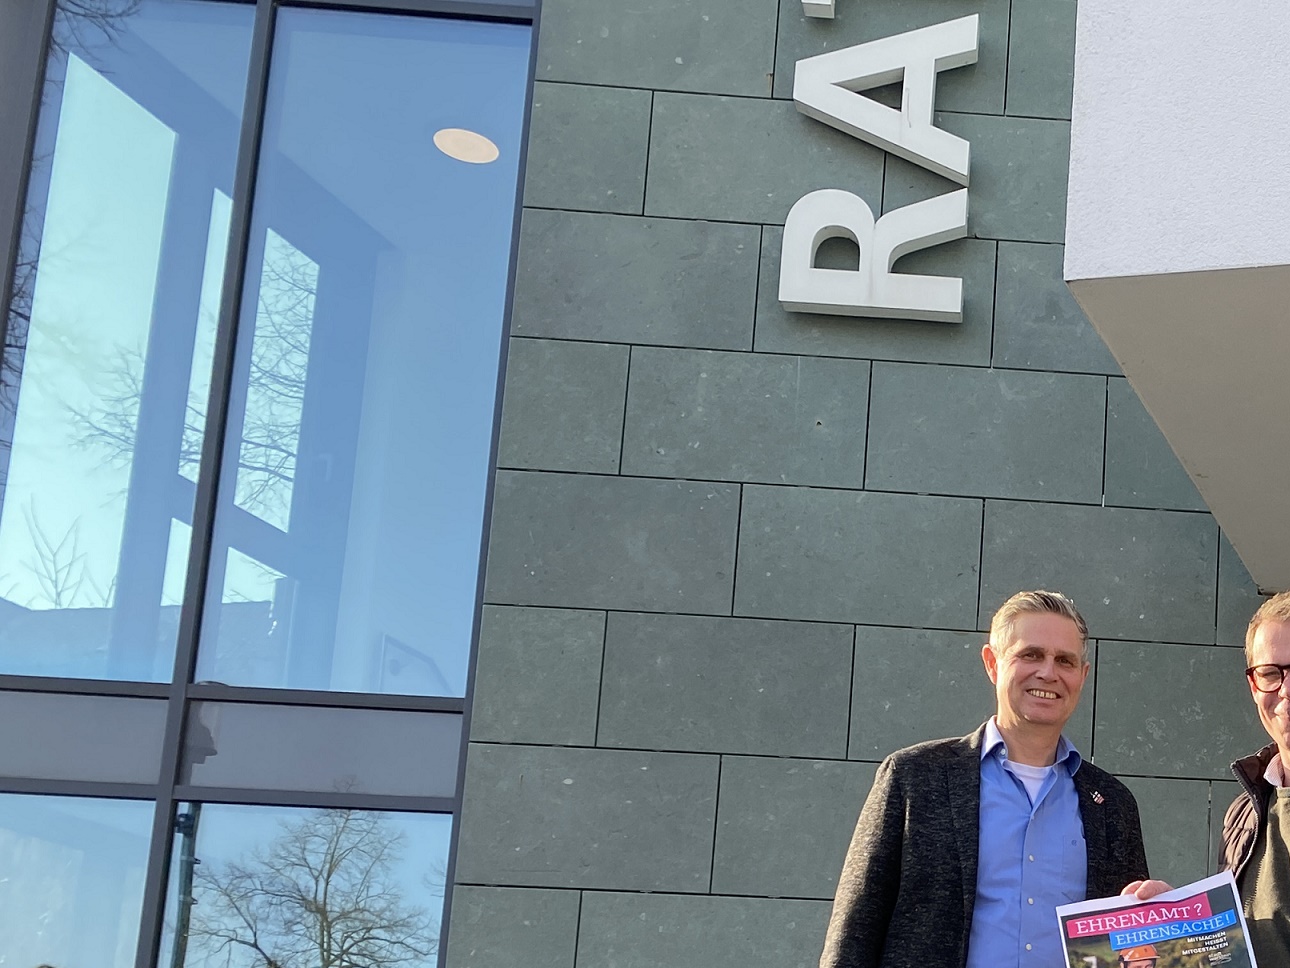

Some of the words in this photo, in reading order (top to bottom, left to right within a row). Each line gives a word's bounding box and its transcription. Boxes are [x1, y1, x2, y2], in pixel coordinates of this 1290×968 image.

[779, 0, 980, 323] RA
[1187, 931, 1226, 943] MITMACHEN
[1204, 937, 1227, 946] HEISST
[1182, 942, 1229, 955] MITGESTALTEN
